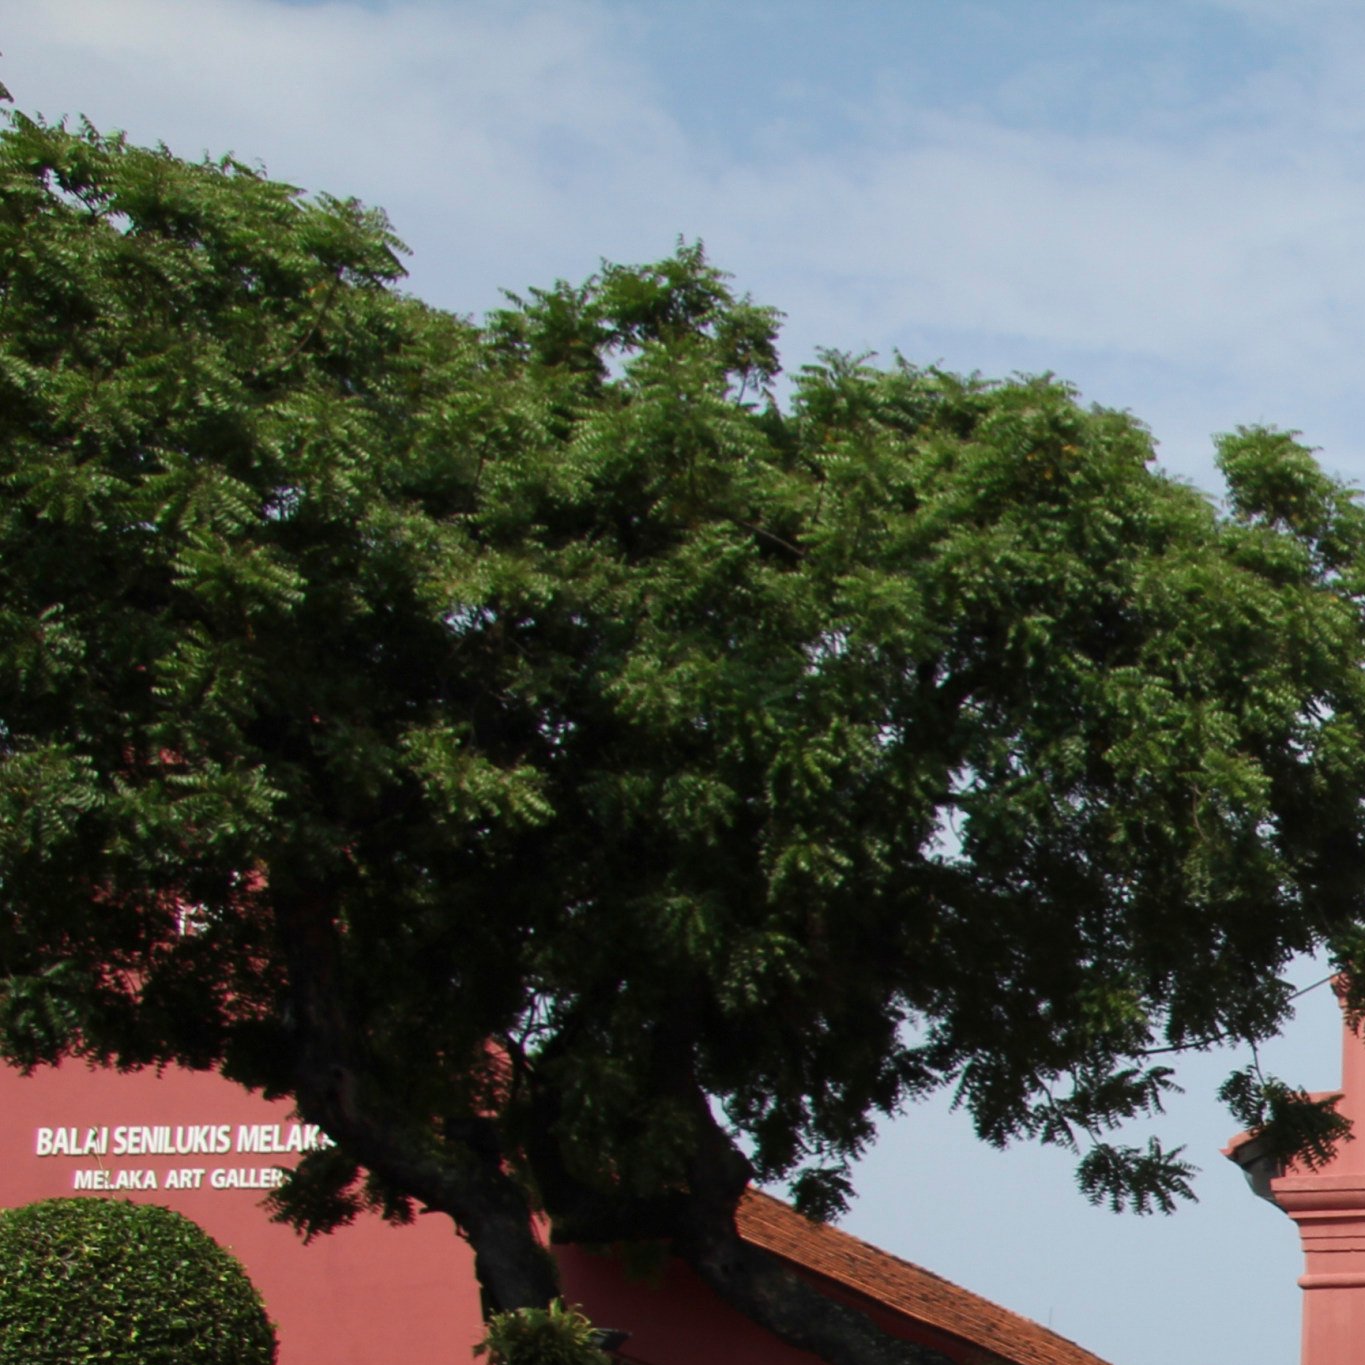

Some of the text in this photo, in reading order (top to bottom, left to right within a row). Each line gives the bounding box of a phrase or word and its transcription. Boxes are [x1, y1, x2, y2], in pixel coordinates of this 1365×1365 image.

[35, 1126, 107, 1157] BALAI
[113, 1124, 232, 1155] SENILUKIS
[74, 1169, 157, 1190] MELAKA
[164, 1168, 206, 1189] ART
